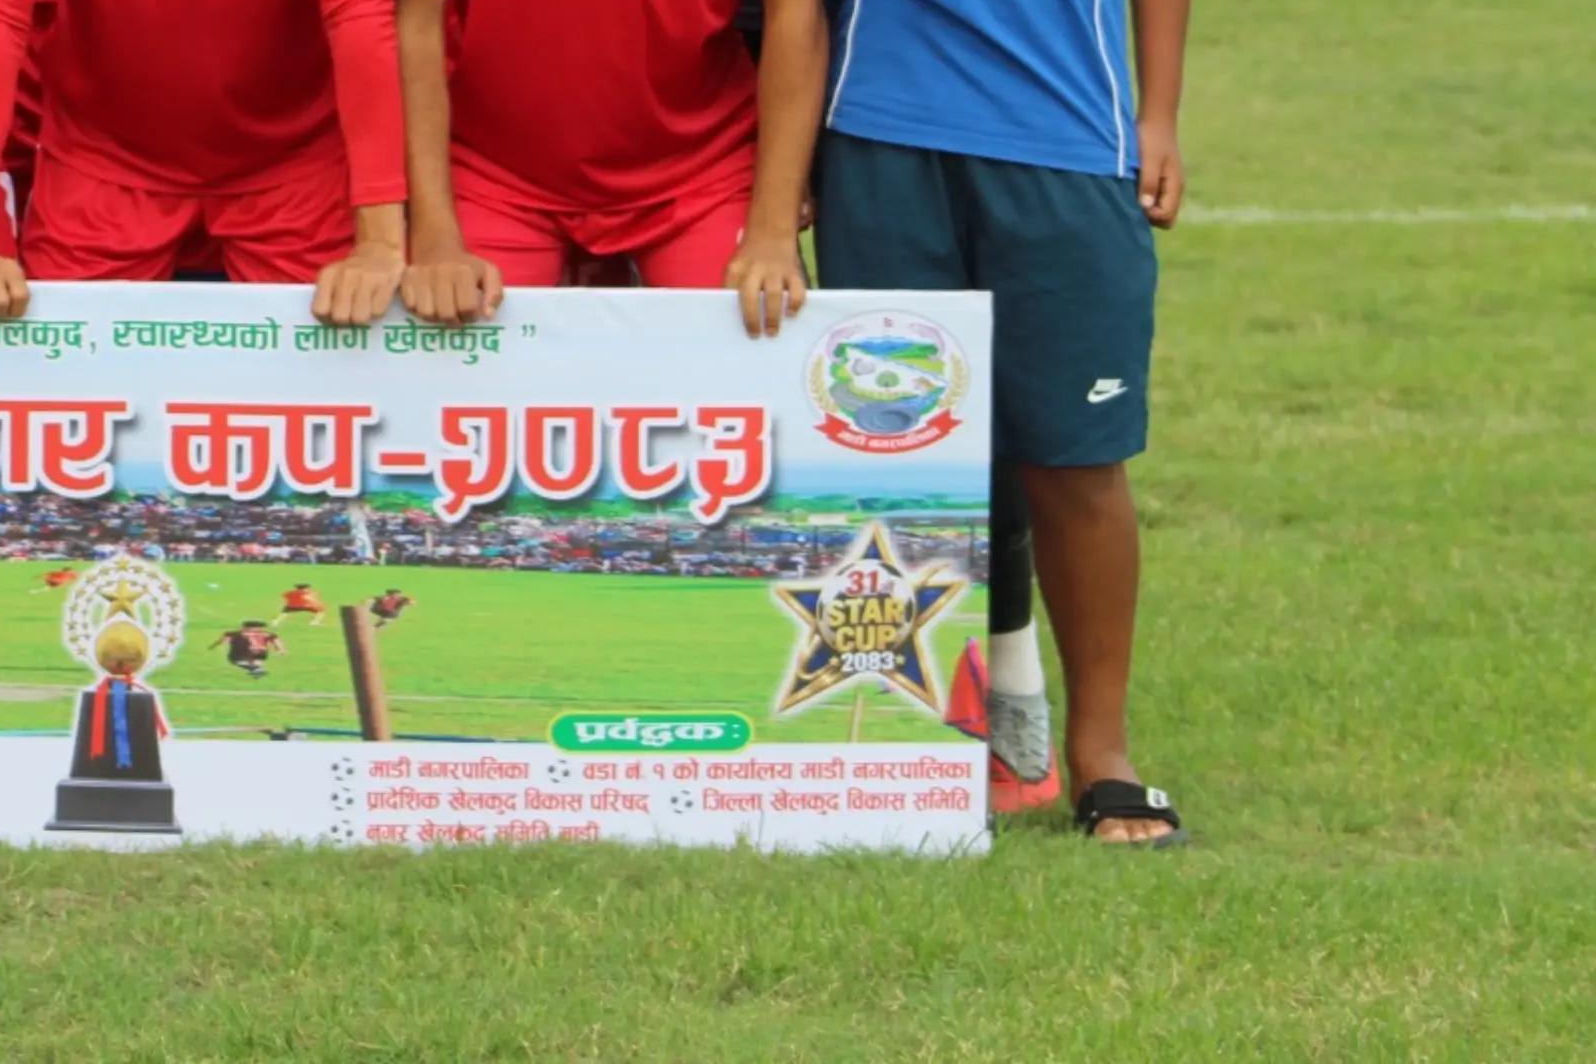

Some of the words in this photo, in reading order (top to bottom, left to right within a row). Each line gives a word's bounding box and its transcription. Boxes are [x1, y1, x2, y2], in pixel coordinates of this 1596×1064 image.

[112, 316, 282, 351] स्वास्थ्यको
[828, 597, 903, 626] STAR
[835, 625, 896, 652] CUP
[841, 651, 894, 672] 2083
[368, 756, 412, 779] माडी
[418, 757, 530, 780] नगरपालिका
[672, 758, 699, 780] को
[706, 758, 793, 780] कार्यालय
[799, 758, 844, 780] माडी
[852, 756, 972, 780] नगरपालिका
[366, 787, 441, 811] प्रादेशिक
[448, 788, 517, 815] खेलकुद
[524, 789, 582, 812] विकास
[702, 788, 762, 812] जिल्ला
[770, 788, 839, 815] खेलकुद
[847, 788, 906, 812] विकास
[912, 787, 971, 812] समिति
